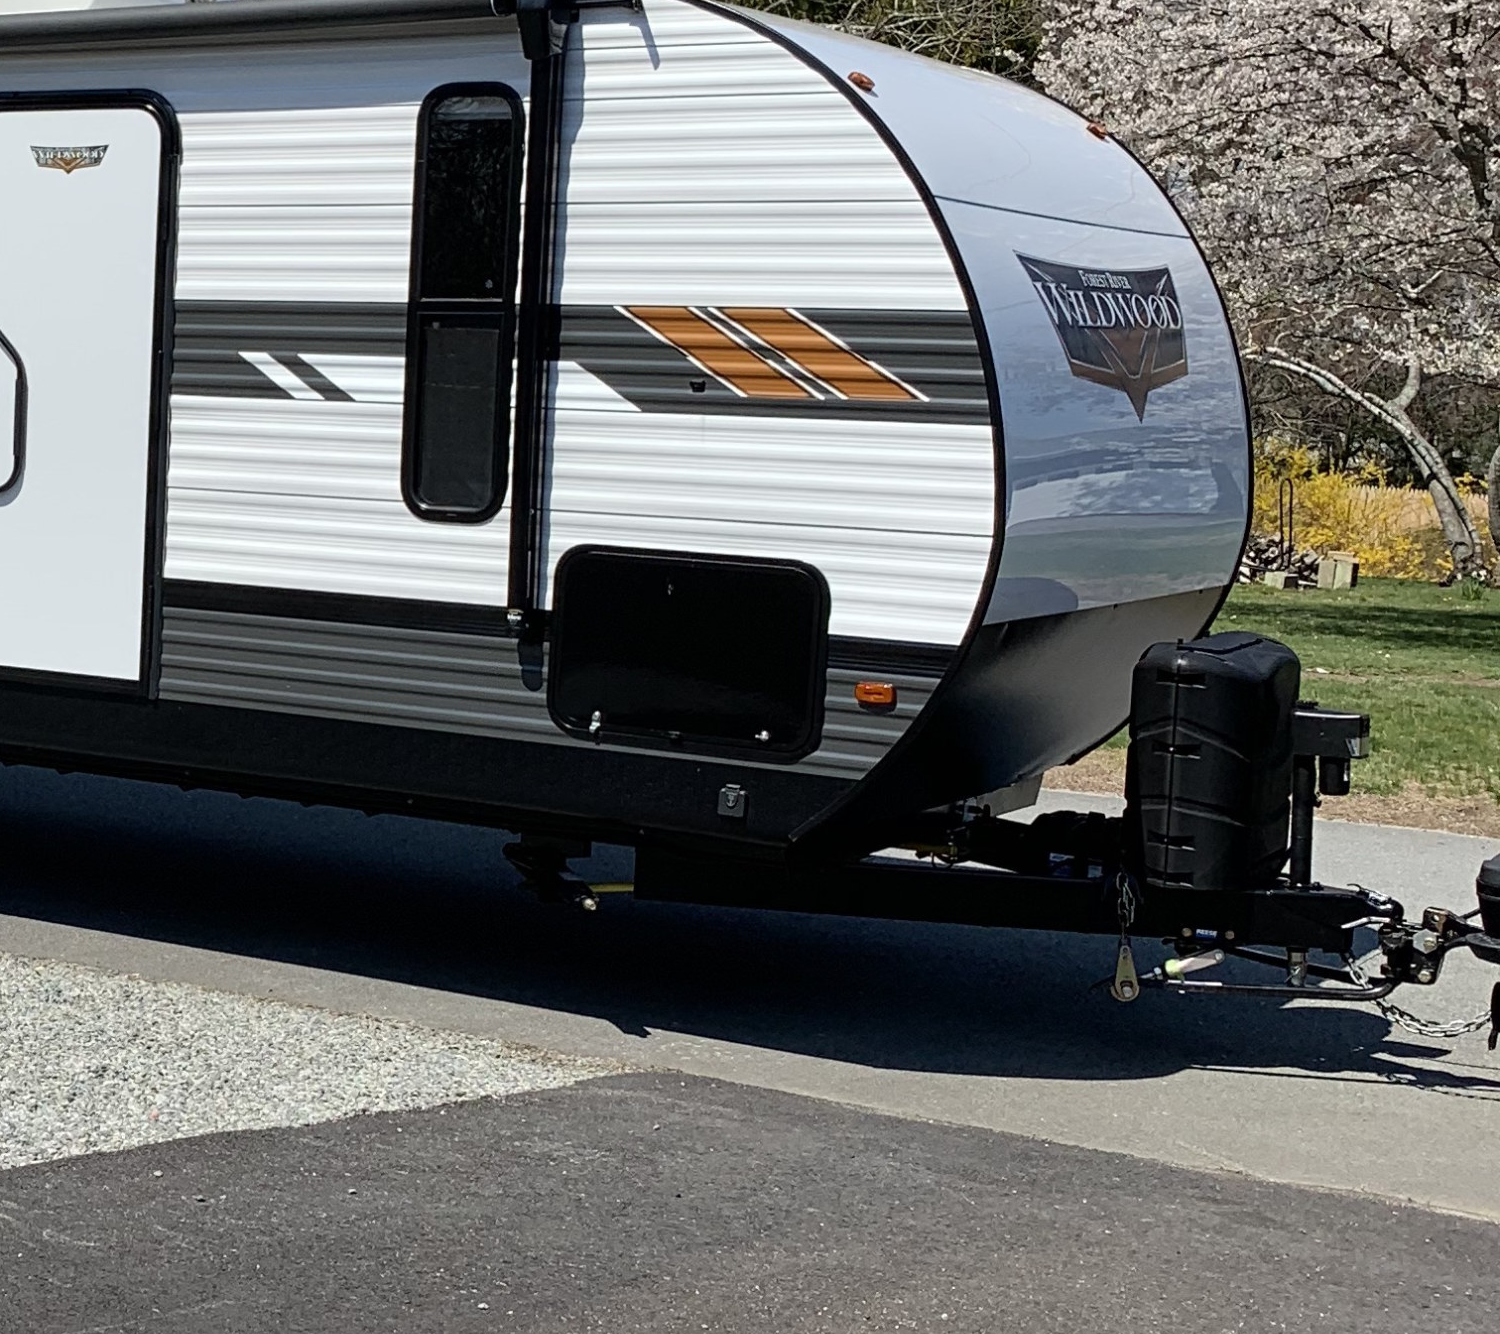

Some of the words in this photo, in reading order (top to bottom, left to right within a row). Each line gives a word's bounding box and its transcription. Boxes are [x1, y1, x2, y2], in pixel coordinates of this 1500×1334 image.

[1078, 270, 1107, 288] FOREST
[1106, 272, 1132, 289] RIVER
[1033, 281, 1182, 329] WILDWOOD
